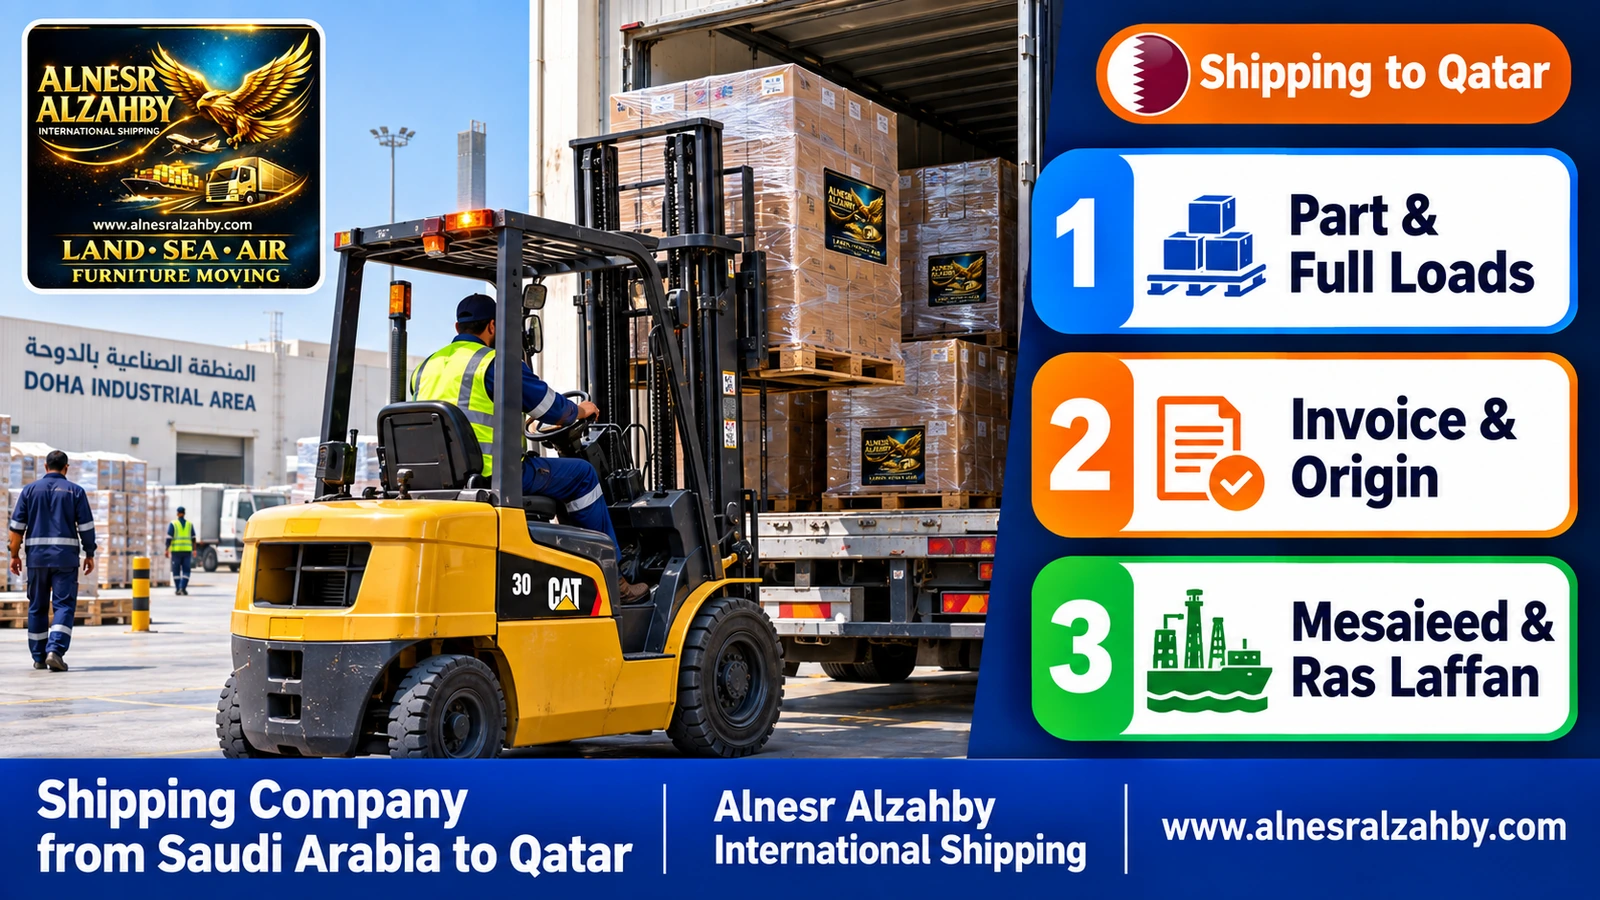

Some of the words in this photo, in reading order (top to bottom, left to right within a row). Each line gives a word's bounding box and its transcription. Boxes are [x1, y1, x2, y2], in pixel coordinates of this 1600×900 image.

[25, 336, 99, 369] بالدوحة
[106, 347, 182, 373] الصناعية
[188, 357, 256, 382] المنطقة
[24, 370, 84, 396] DOHA
[91, 378, 203, 407] INDUSTRIAL
[209, 391, 257, 412] AREA
[511, 572, 532, 596] 30
[547, 577, 582, 611] CAT
